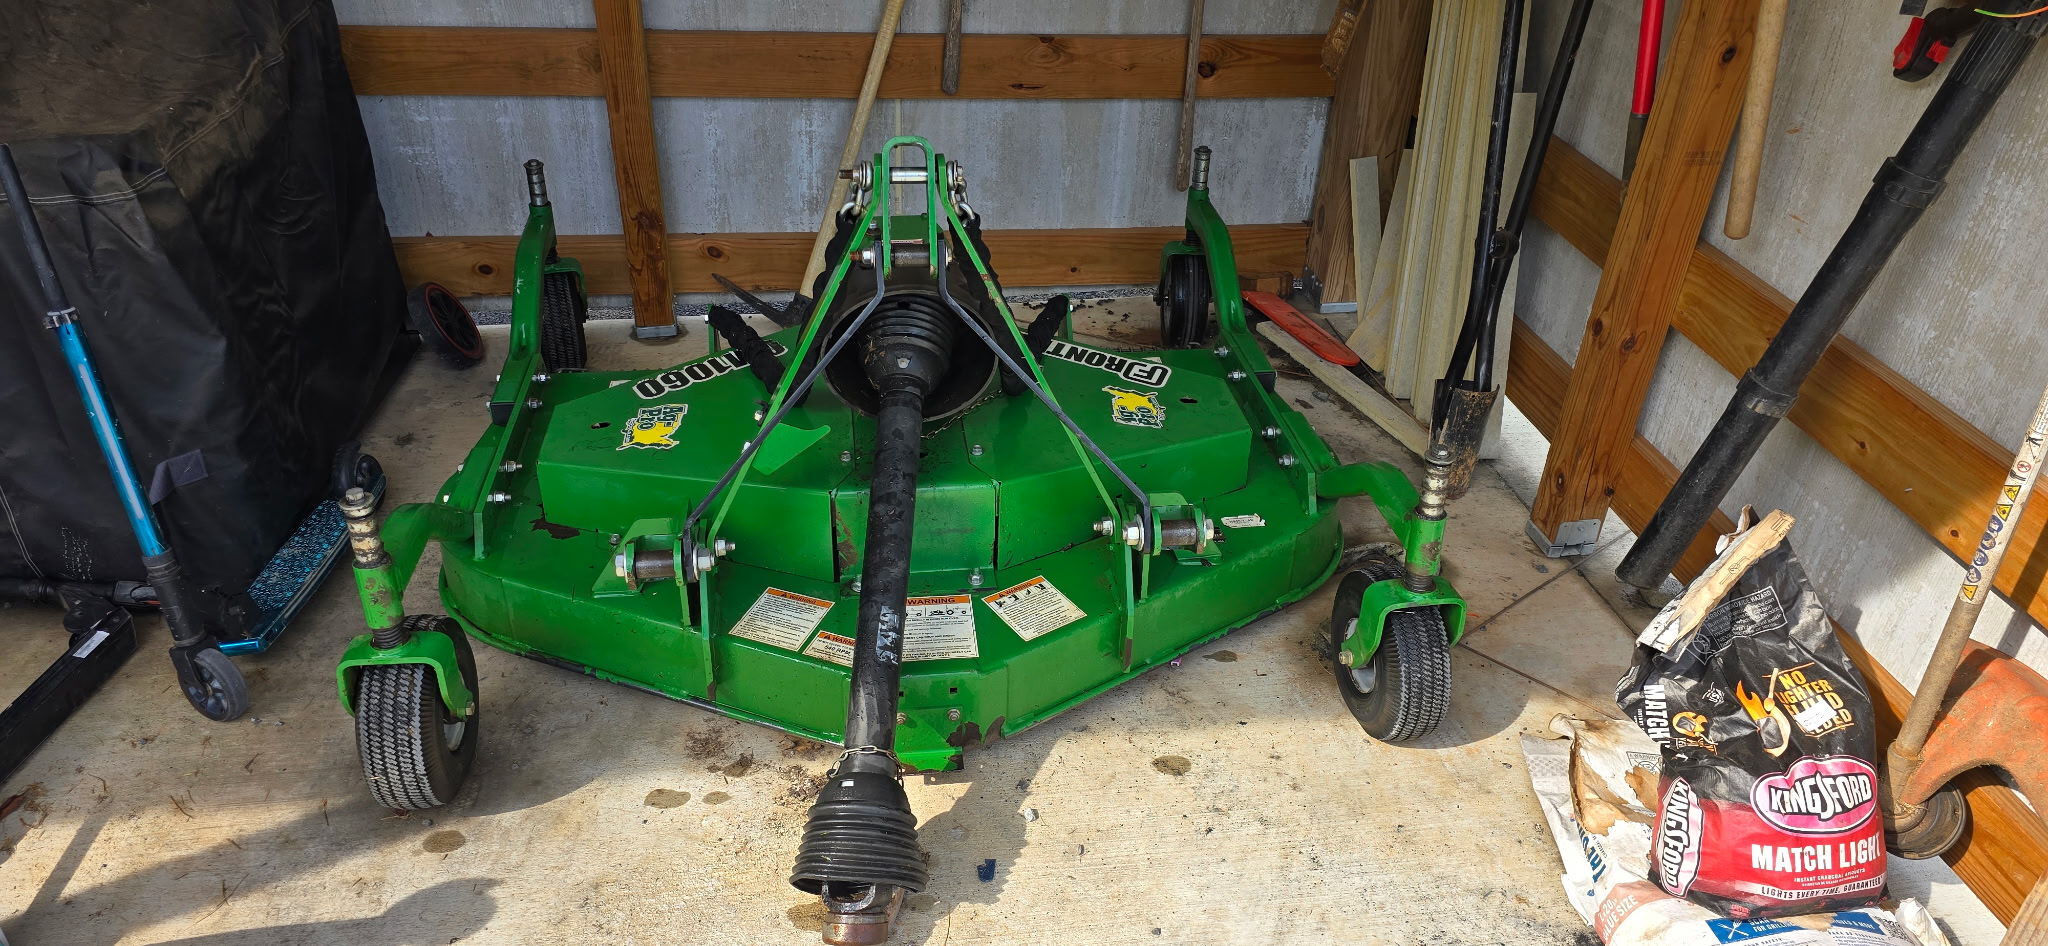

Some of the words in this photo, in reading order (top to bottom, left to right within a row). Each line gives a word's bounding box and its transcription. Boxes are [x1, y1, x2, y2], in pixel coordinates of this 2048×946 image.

[1045, 342, 1170, 387] FRONT
[907, 596, 956, 605] WARNING
[1750, 590, 1772, 602] HAZARD
[1778, 670, 1807, 690] NO
[1643, 684, 1671, 739] MATCH
[1770, 772, 1873, 820] KINGSFORD
[1662, 780, 1691, 888] KINGSFORD
[1751, 843, 1833, 873] MATCH
[1840, 832, 1881, 869] LIGHT
[1617, 894, 1639, 917] SIZE
[1761, 886, 1793, 899] LIGHTS
[1796, 890, 1820, 899] EVERY
